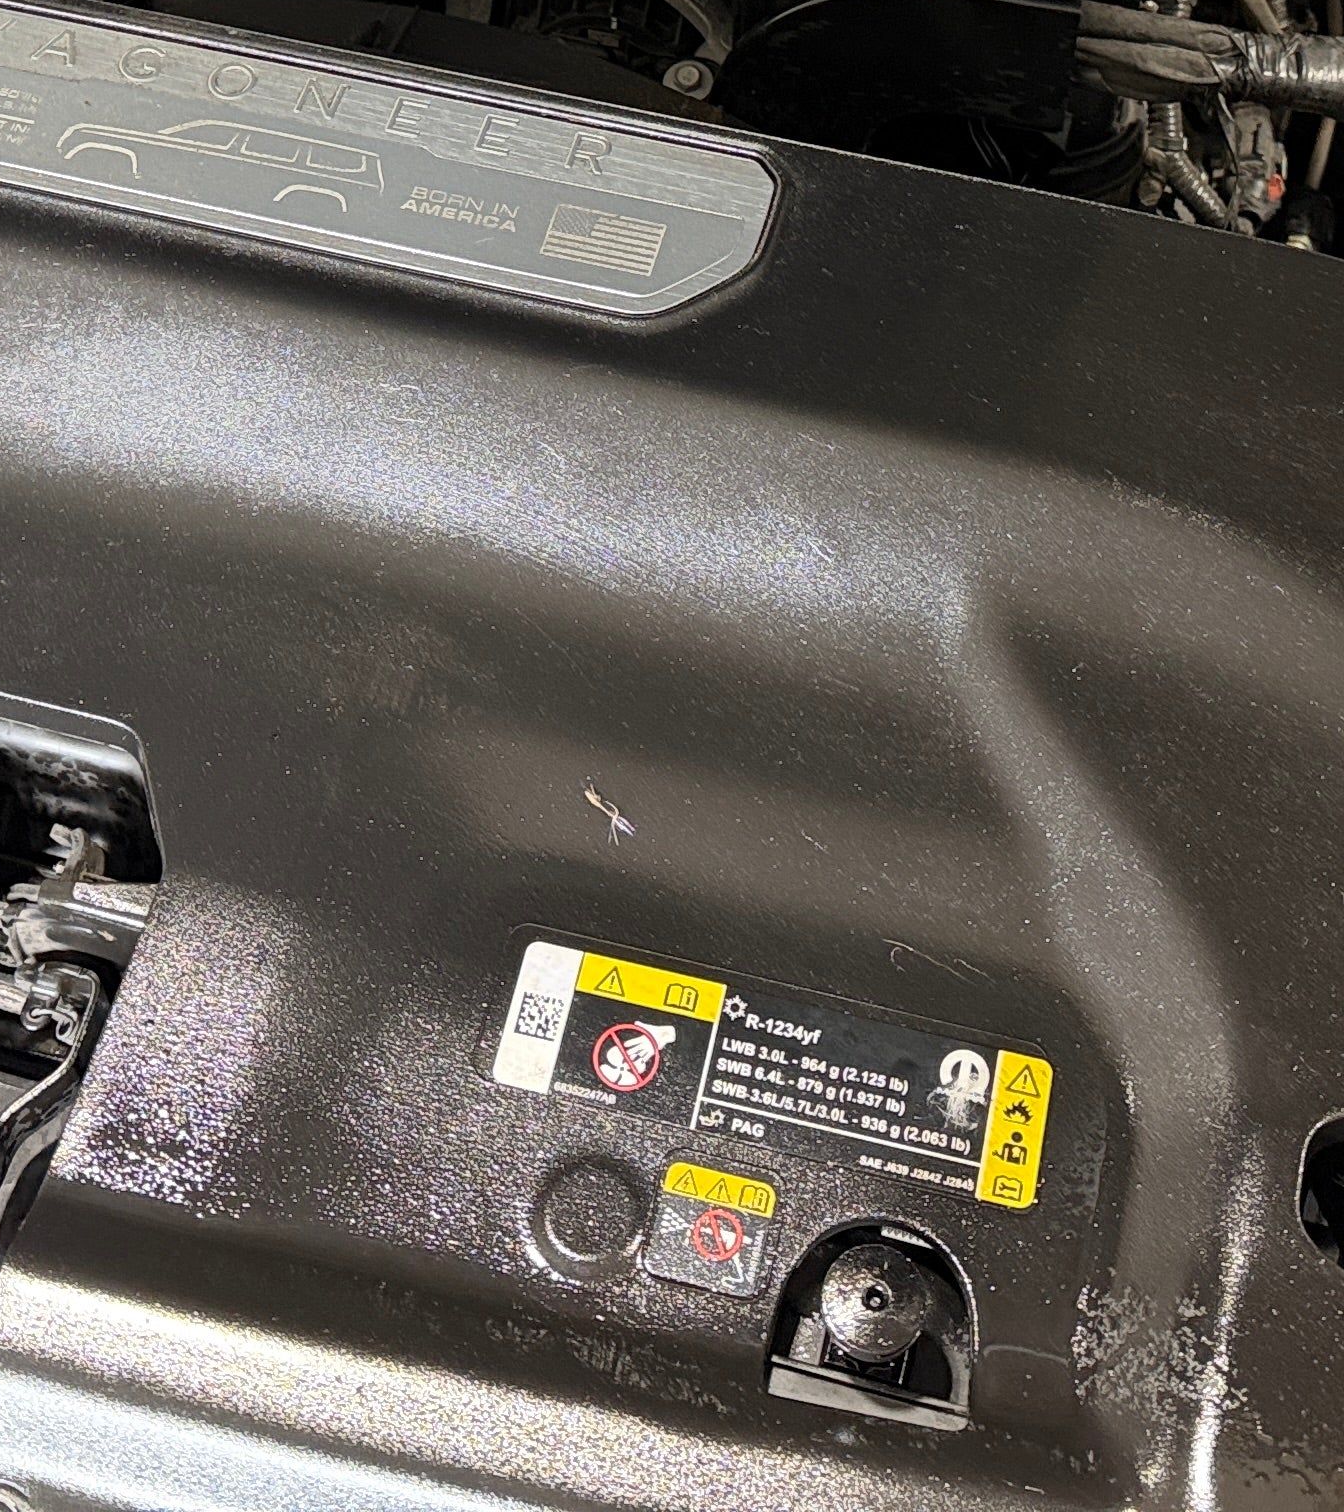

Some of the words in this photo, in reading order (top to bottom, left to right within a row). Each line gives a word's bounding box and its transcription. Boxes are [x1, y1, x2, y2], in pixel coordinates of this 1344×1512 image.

[400, 199, 516, 233] AMERICA
[409, 186, 485, 212] BORN
[491, 202, 520, 219] IN
[744, 1013, 823, 1046] R-1234yf
[721, 1038, 756, 1057] LWB
[758, 1045, 789, 1065] 3.0L
[800, 1056, 827, 1075] 964
[829, 1065, 840, 1080] g
[842, 1066, 887, 1088] (2.125
[888, 1077, 909, 1096] lb)
[716, 1057, 752, 1078] SWB
[754, 1065, 786, 1086] 6.4L
[797, 1076, 824, 1095] 879
[825, 1085, 837, 1101] g
[839, 1087, 884, 1109] (1.937
[885, 1097, 906, 1117] lb)
[711, 1079, 748, 1099] SWB
[860, 1114, 888, 1134] 936
[889, 1124, 901, 1140] g
[903, 1125, 948, 1148] (2.063
[950, 1136, 971, 1156] lb)
[730, 1118, 765, 1138] PAG
[859, 1155, 883, 1170] SAE
